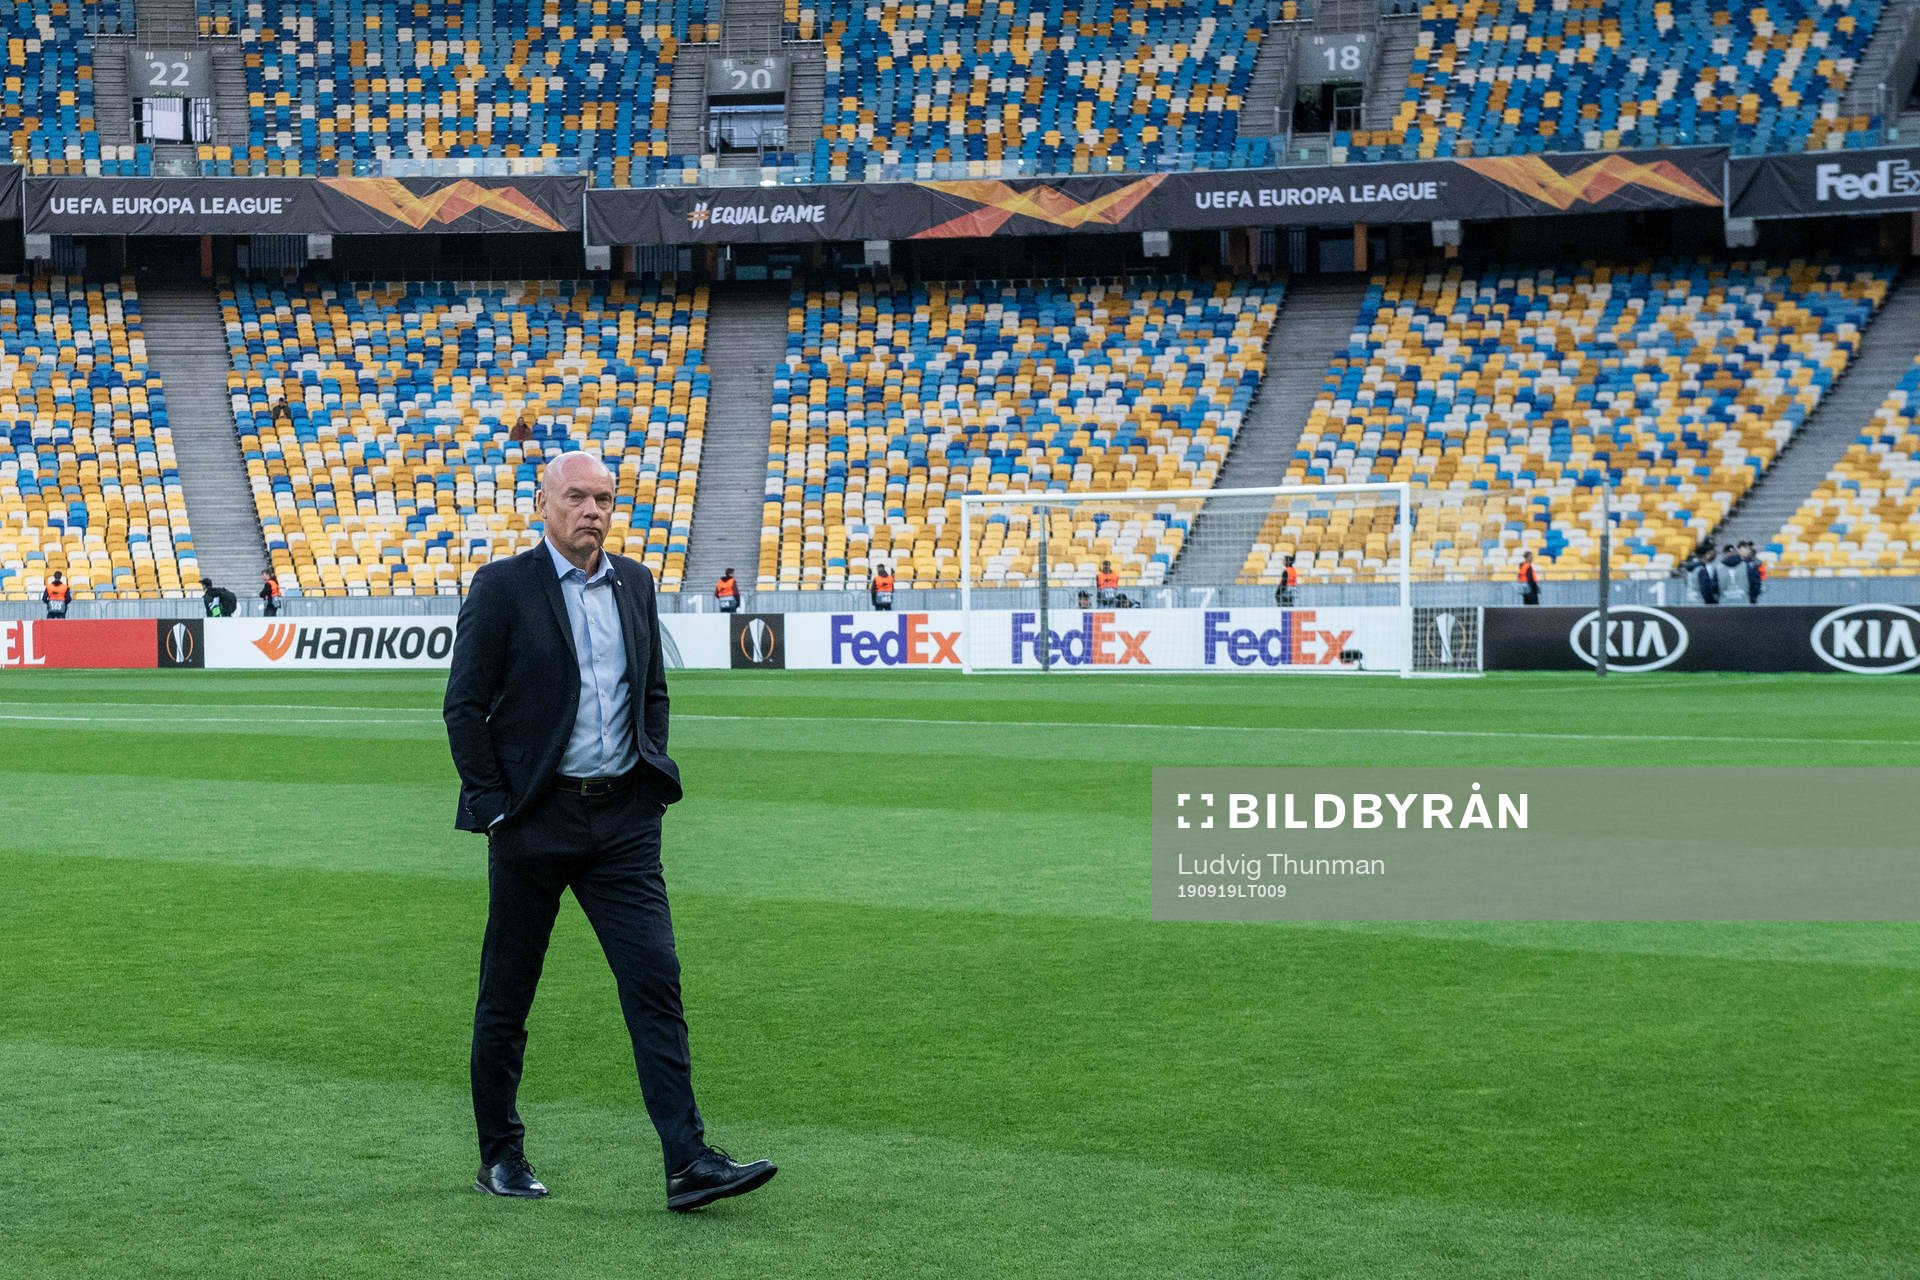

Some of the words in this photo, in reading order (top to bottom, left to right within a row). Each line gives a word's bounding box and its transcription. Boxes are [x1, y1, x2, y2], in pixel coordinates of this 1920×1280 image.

[149, 61, 190, 86] 22
[1323, 45, 1361, 71] 18
[50, 197, 107, 215] UEFA
[112, 197, 195, 215] EUROPA
[199, 197, 283, 215] LEAGUE
[1196, 191, 1253, 209] UEFA
[1258, 186, 1345, 207] EUROPA
[1349, 181, 1438, 203] LEAGUE
[831, 613, 962, 666] FedEx
[1011, 612, 1151, 666] FedEx
[1204, 610, 1355, 666] FedEx
[1590, 620, 1668, 657] KIA
[1832, 619, 1917, 658] KIA
